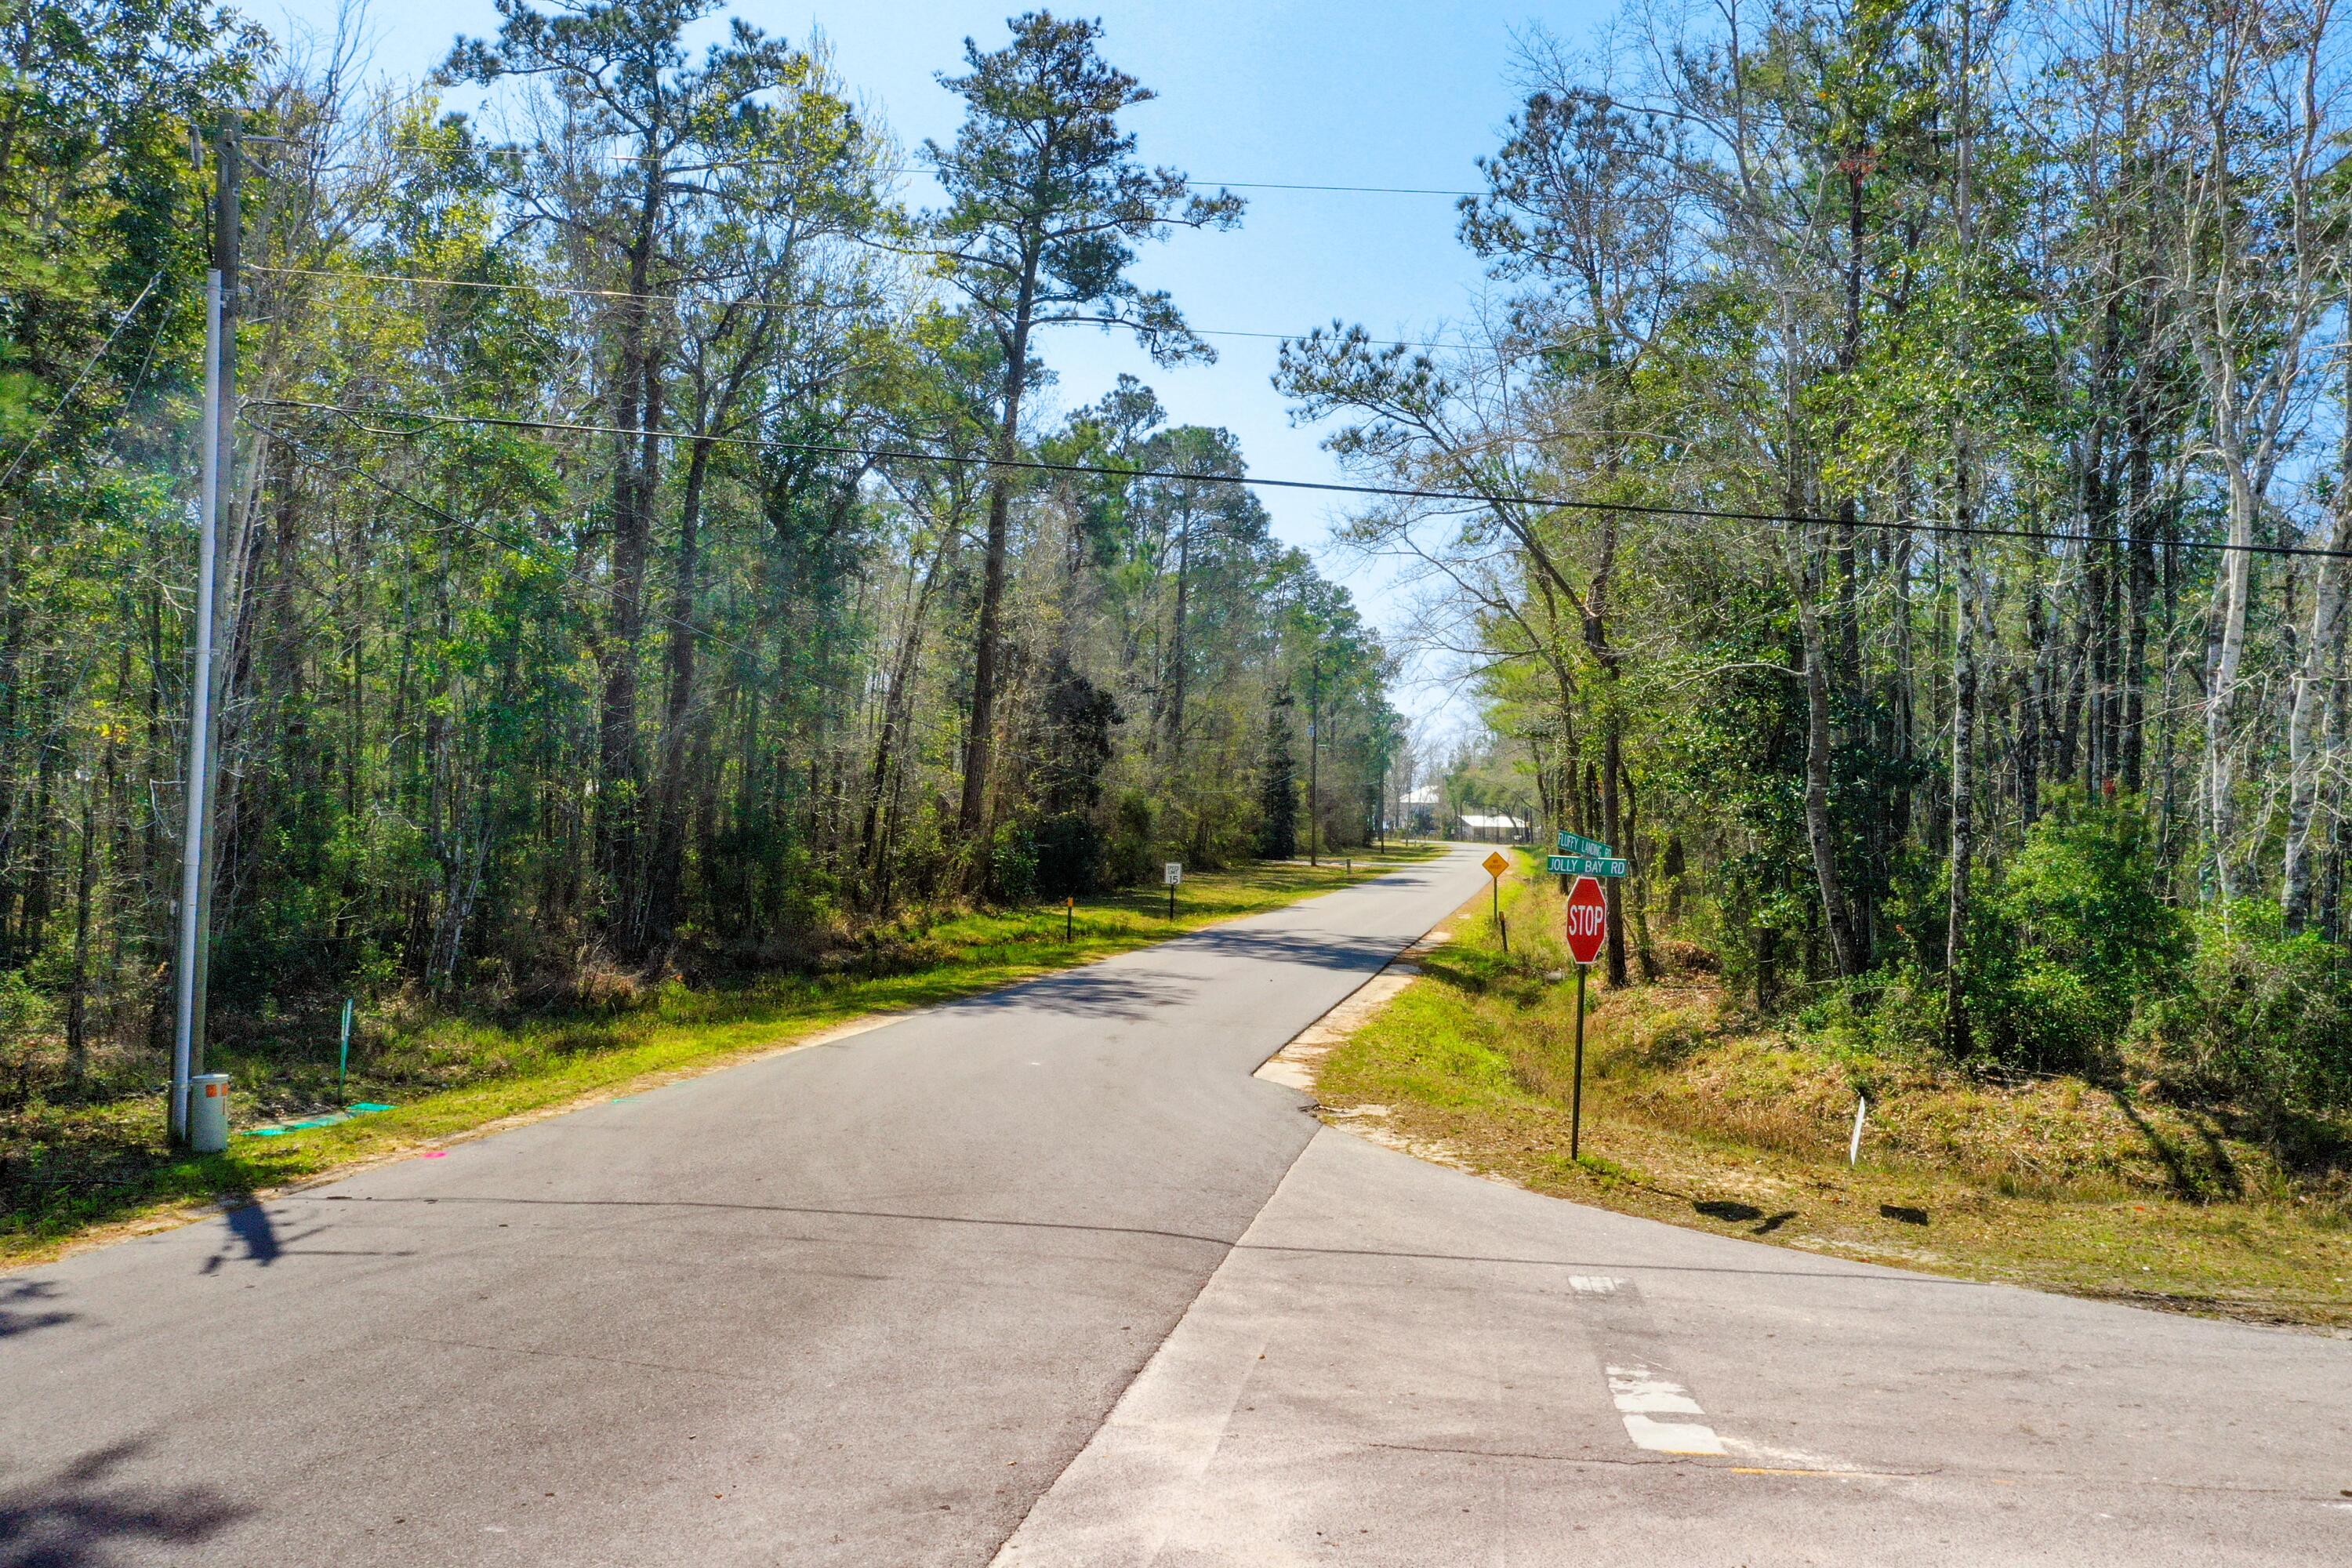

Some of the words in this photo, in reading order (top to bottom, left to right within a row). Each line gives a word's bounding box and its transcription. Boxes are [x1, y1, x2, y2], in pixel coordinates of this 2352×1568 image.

[1558, 833, 1578, 850] FLUFFY
[1581, 840, 1602, 857] LANDING
[1604, 848, 1612, 858] RD
[1548, 858, 1578, 872] JOLLY
[1584, 860, 1604, 873] BAY
[1610, 861, 1625, 874] RD
[1170, 875, 1178, 884] 15
[1569, 905, 1603, 936] STOP
